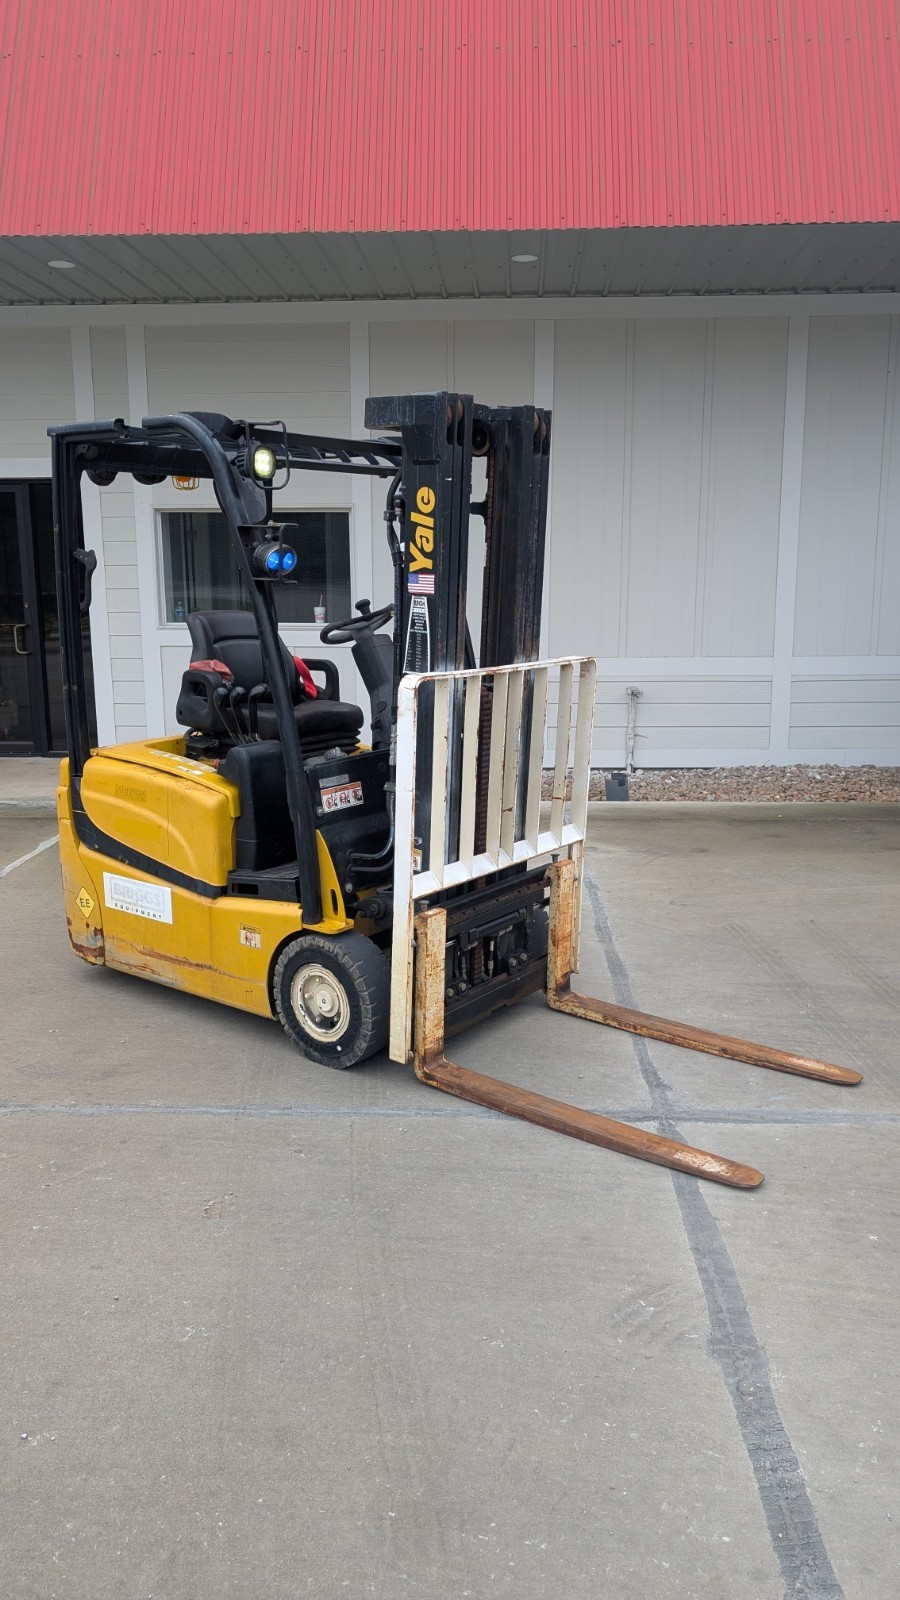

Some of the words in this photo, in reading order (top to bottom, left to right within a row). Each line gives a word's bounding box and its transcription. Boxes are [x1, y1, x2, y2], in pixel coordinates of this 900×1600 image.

[409, 486, 436, 573] Yale
[79, 898, 91, 908] EE
[113, 883, 161, 907] BRIGGS
[114, 903, 162, 919] EQUIPMENT
